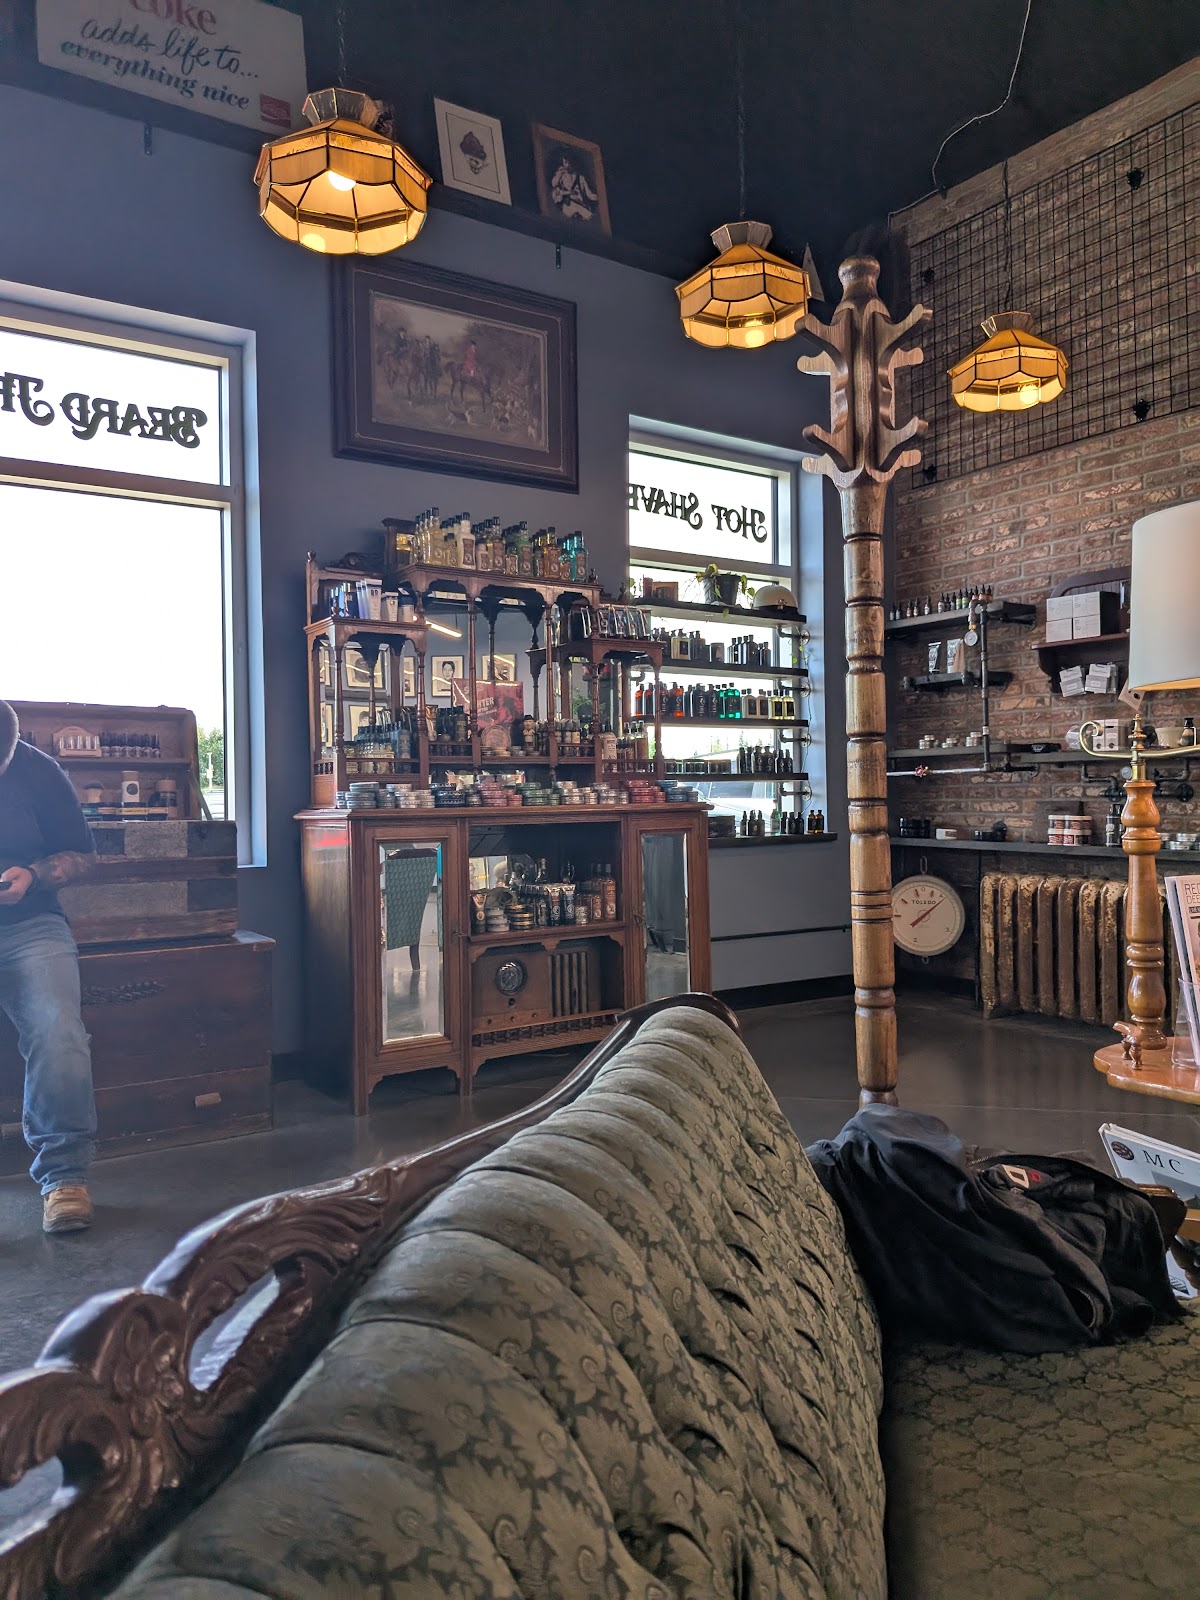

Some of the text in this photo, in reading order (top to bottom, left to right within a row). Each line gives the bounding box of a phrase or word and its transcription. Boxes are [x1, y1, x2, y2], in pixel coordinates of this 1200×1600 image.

[60, 38, 201, 98] everything
[202, 83, 251, 111] nice
[80, 17, 156, 52] adds
[160, 27, 211, 76] life
